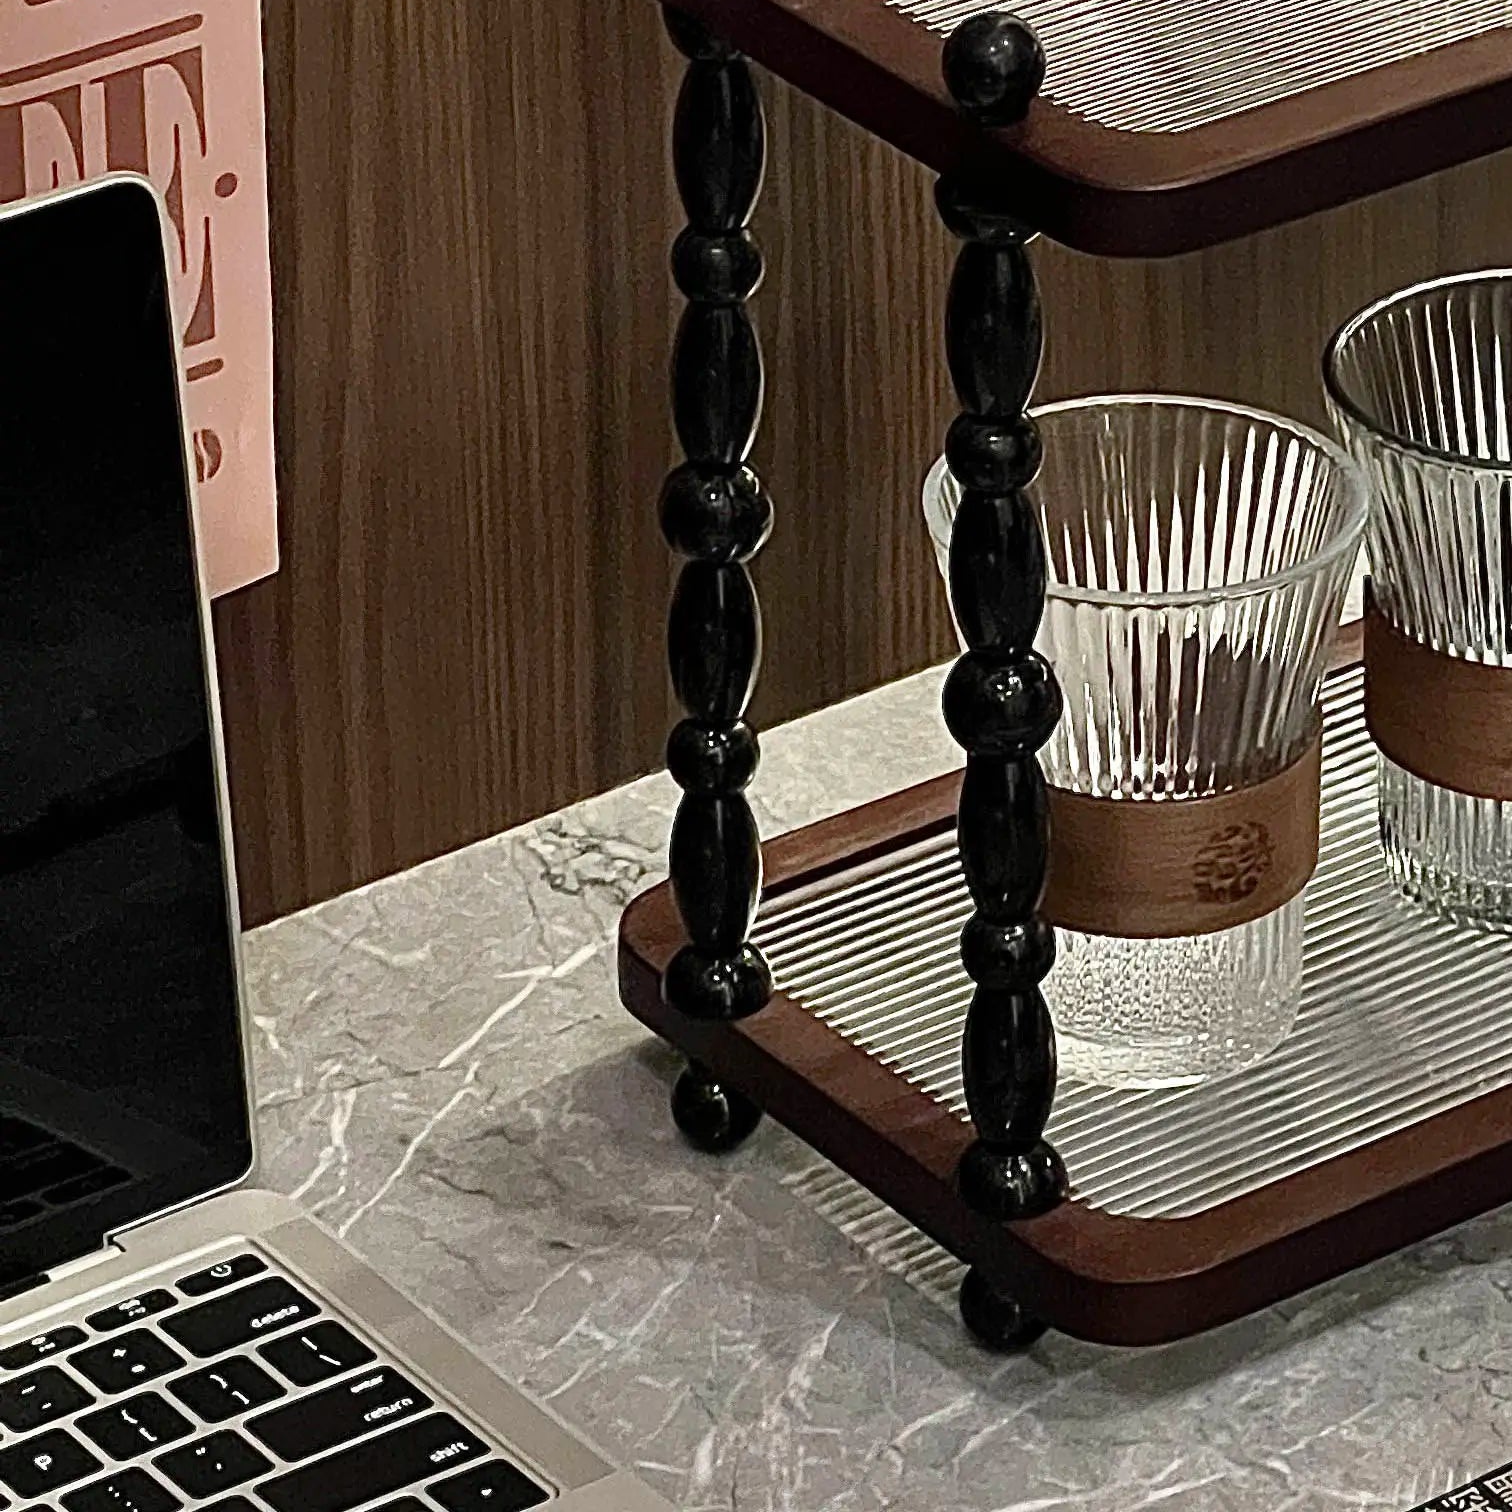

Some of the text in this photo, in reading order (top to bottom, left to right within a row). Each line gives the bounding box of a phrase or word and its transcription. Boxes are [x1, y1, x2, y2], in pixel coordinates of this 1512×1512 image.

[363, 1397, 414, 1423] return
[33, 1453, 53, 1472] P
[429, 1441, 470, 1464] shift
